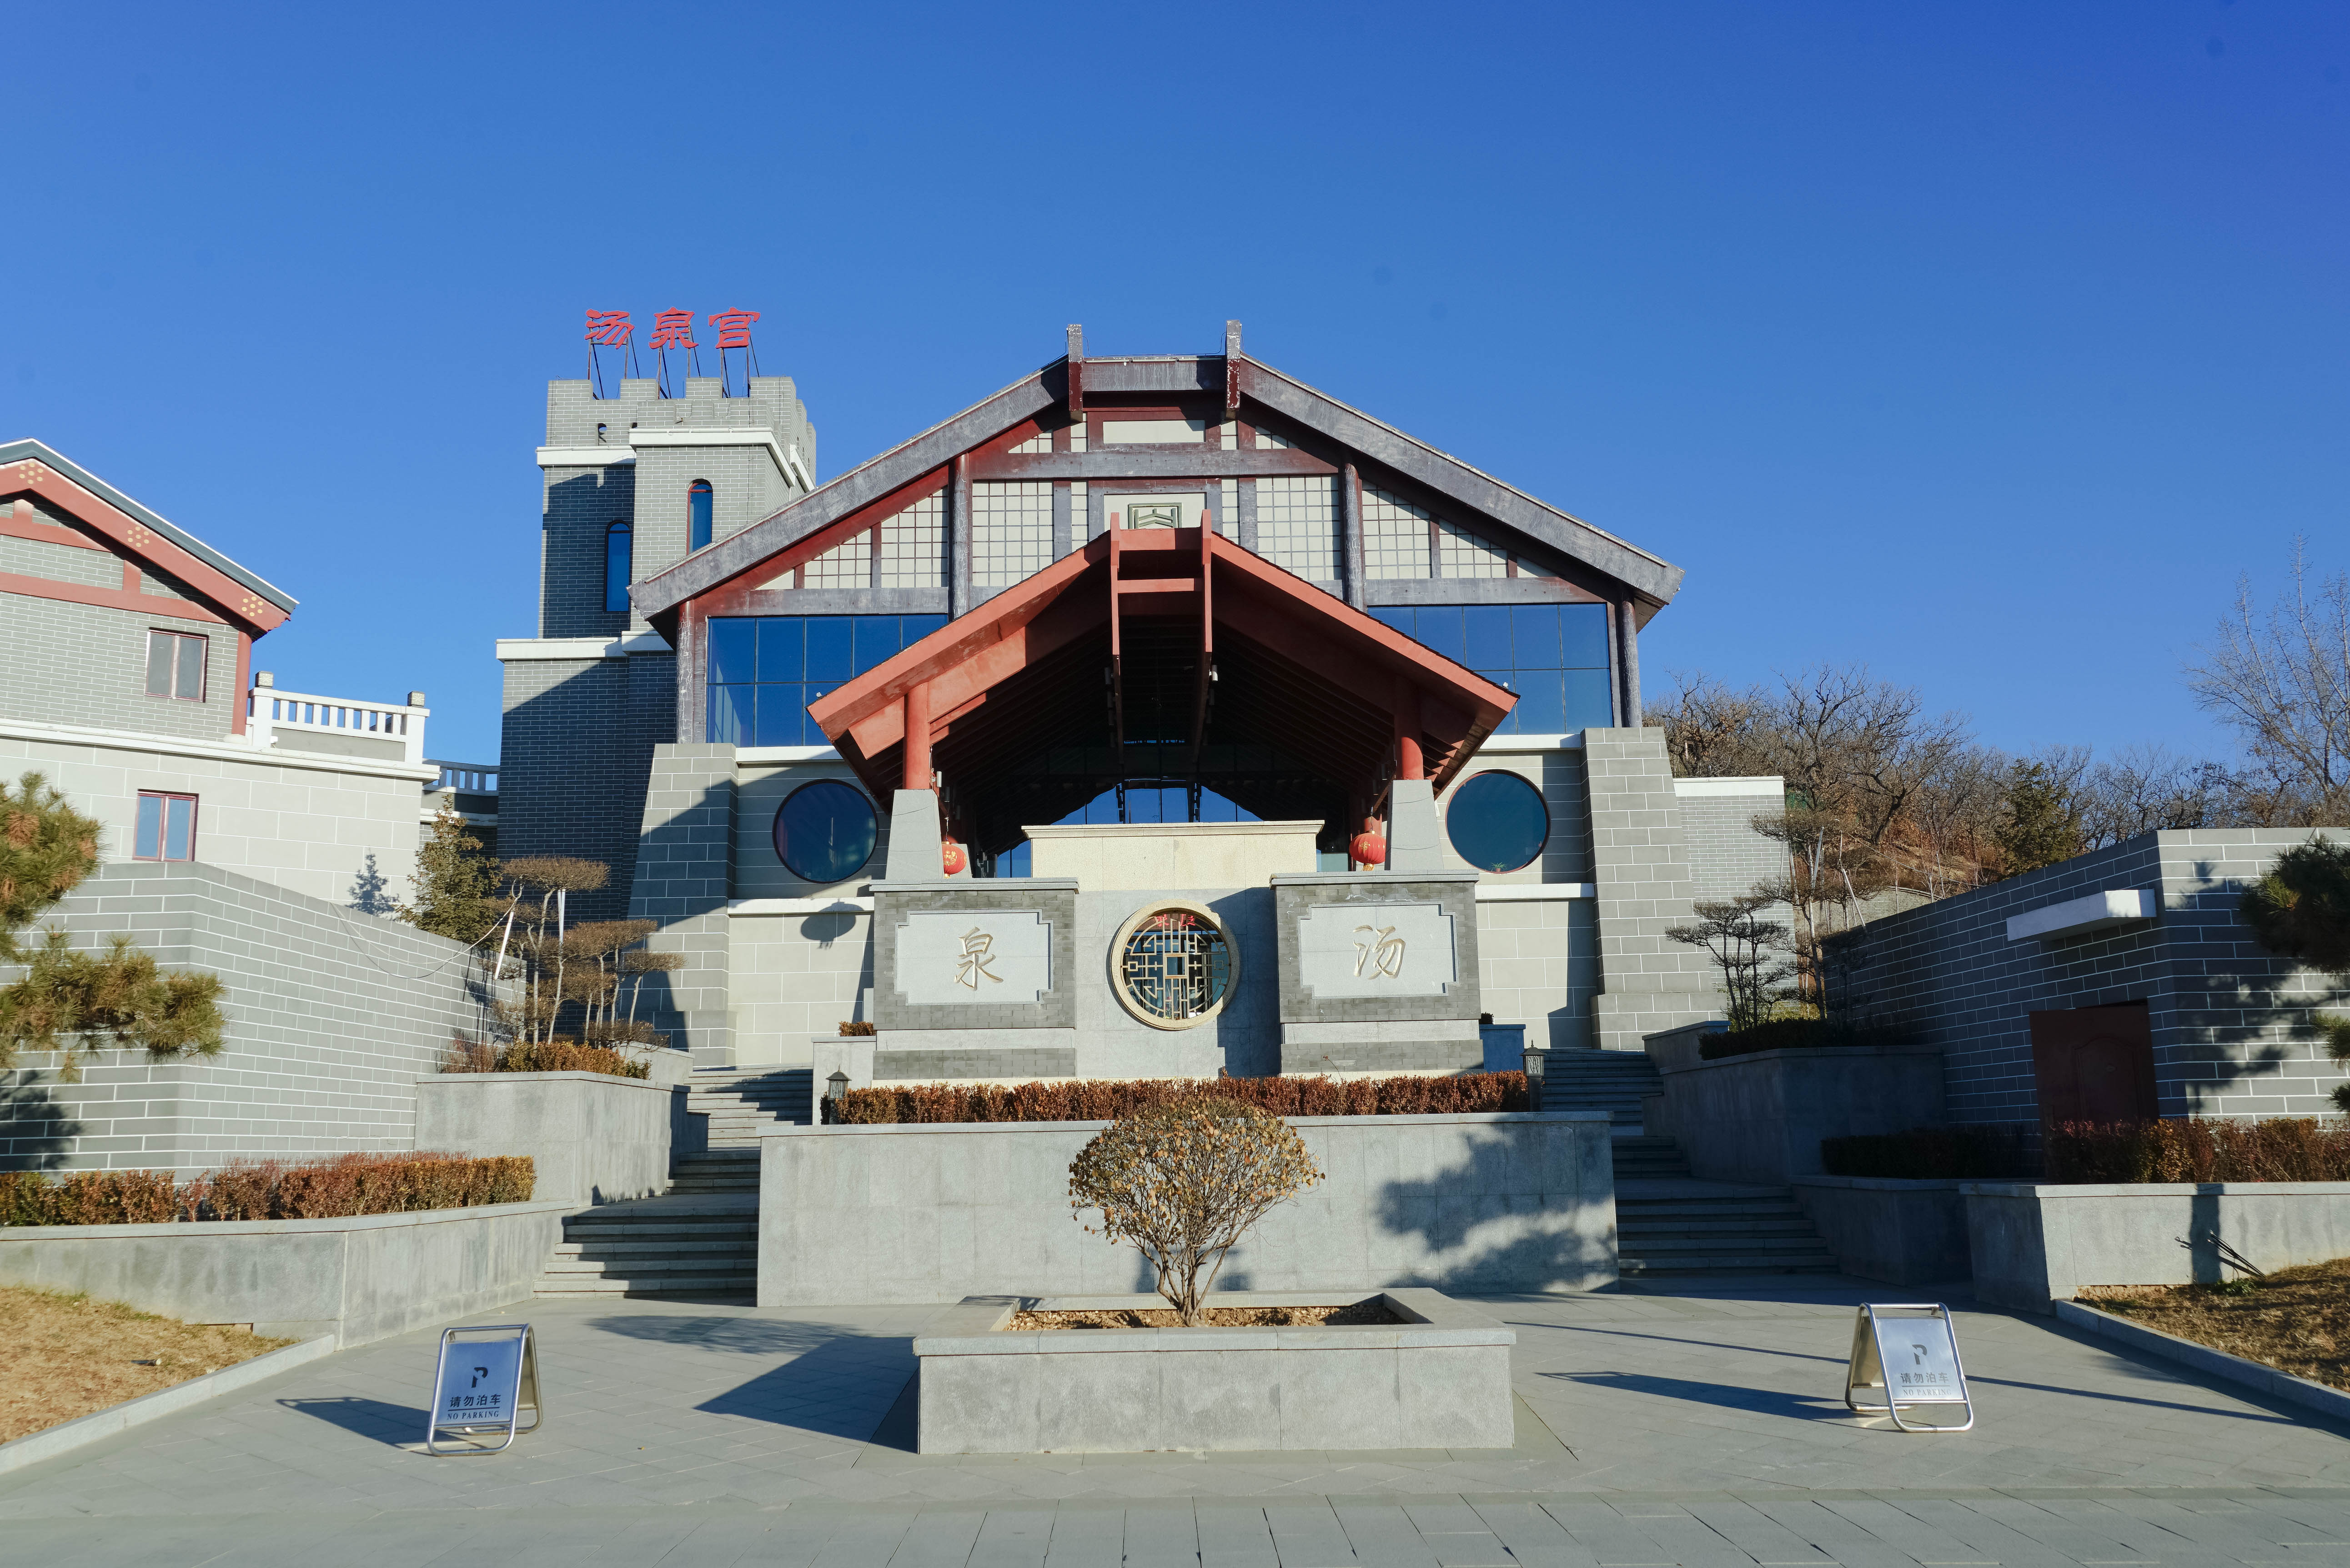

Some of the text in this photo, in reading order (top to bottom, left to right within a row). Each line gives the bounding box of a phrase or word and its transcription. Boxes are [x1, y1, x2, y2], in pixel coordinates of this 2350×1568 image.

[585, 307, 761, 349] 汤泉宫
[954, 926, 1004, 991] 泉
[1353, 925, 1406, 980] 汤
[1912, 1344, 1928, 1365] P
[471, 1367, 488, 1388] P
[1900, 1372, 1949, 1384] 请勿泊车
[450, 1393, 501, 1407] 请勿泊车
[462, 1411, 499, 1419] PARKING
